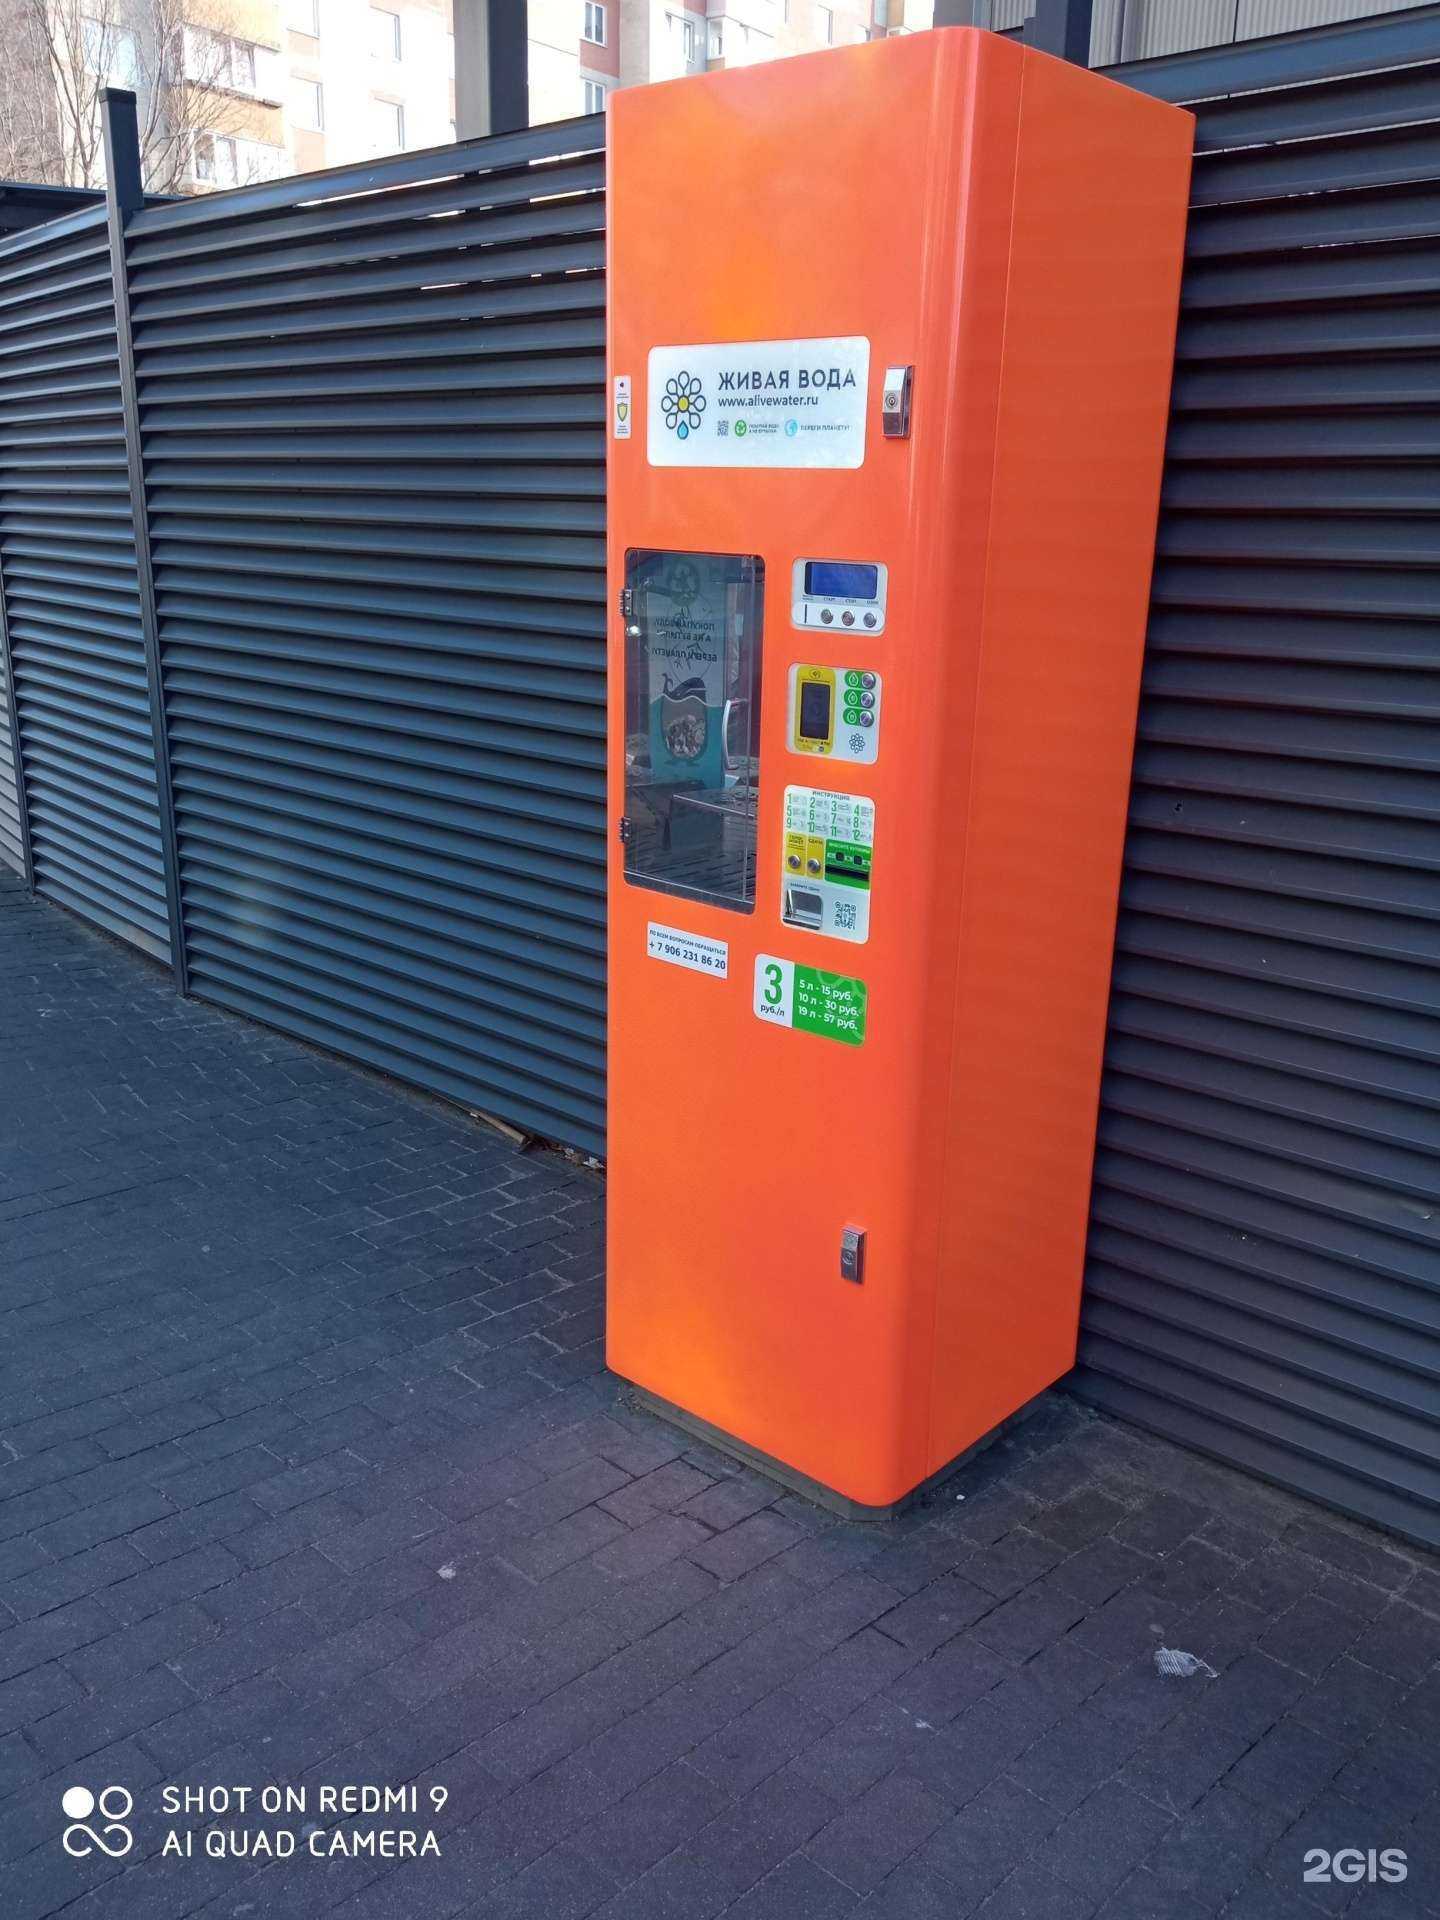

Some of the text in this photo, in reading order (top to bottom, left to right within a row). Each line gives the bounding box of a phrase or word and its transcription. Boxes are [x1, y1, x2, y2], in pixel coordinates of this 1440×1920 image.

[718, 368, 857, 391] ЖИВАЯ ВОДА
[718, 394, 819, 407] www.alivewater.ru
[787, 793, 792, 804] 1
[809, 797, 816, 808] 2
[786, 805, 792, 816] 5
[831, 800, 837, 812] 3
[853, 804, 860, 816] 4
[809, 809, 815, 820] 6
[831, 812, 837, 824] 7
[786, 818, 792, 829] 9
[807, 822, 815, 833] 10
[853, 816, 859, 828] 8
[830, 826, 837, 836] 11
[852, 829, 861, 840] 12
[657, 942, 663, 952] 7
[664, 944, 681, 957] 906
[683, 950, 699, 963] 231
[701, 955, 712, 966] 86
[714, 959, 726, 970] 20
[764, 963, 783, 1005] 3
[799, 979, 805, 989] 5
[806, 983, 814, 991] л
[821, 985, 831, 995] 15
[832, 989, 854, 1001] руб.
[760, 1003, 785, 1017] руб./л
[798, 992, 809, 1003] 10
[810, 996, 817, 1005] л
[824, 1000, 837, 1011] 30
[838, 1004, 860, 1017] руб.
[798, 1005, 808, 1016] 19
[809, 1010, 816, 1018] л
[823, 1013, 835, 1024] 57
[836, 1018, 858, 1030] руб.
